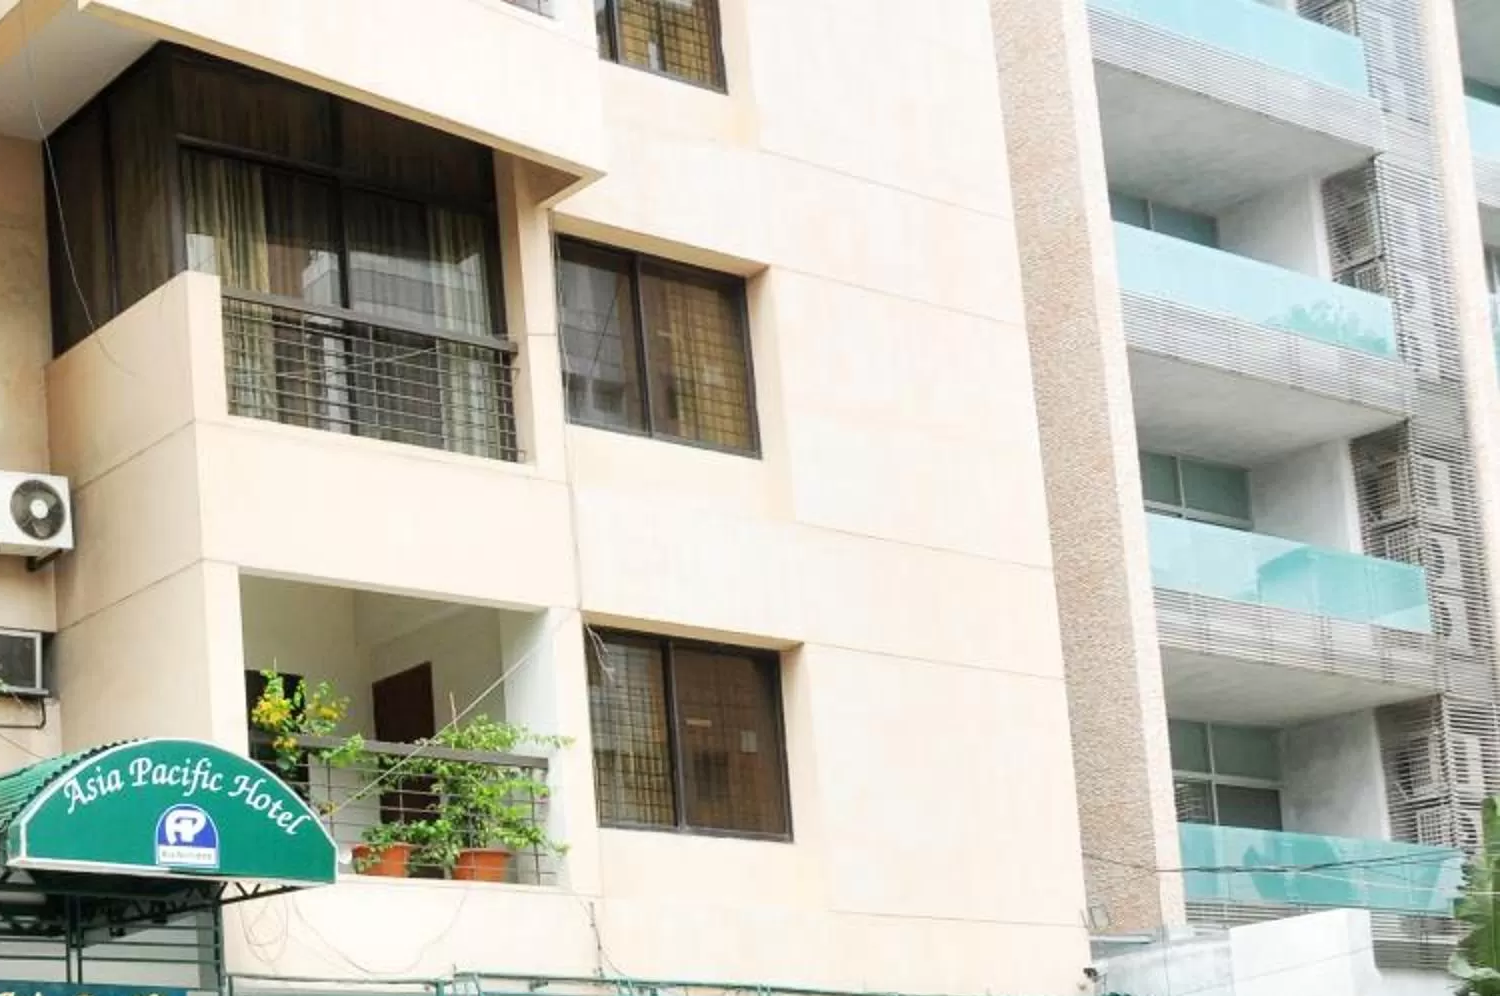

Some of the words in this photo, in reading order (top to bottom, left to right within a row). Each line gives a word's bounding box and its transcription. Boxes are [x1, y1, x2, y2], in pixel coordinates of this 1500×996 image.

[63, 766, 123, 814] Asia
[129, 757, 223, 796] Pacific
[227, 774, 312, 836] Hotel
